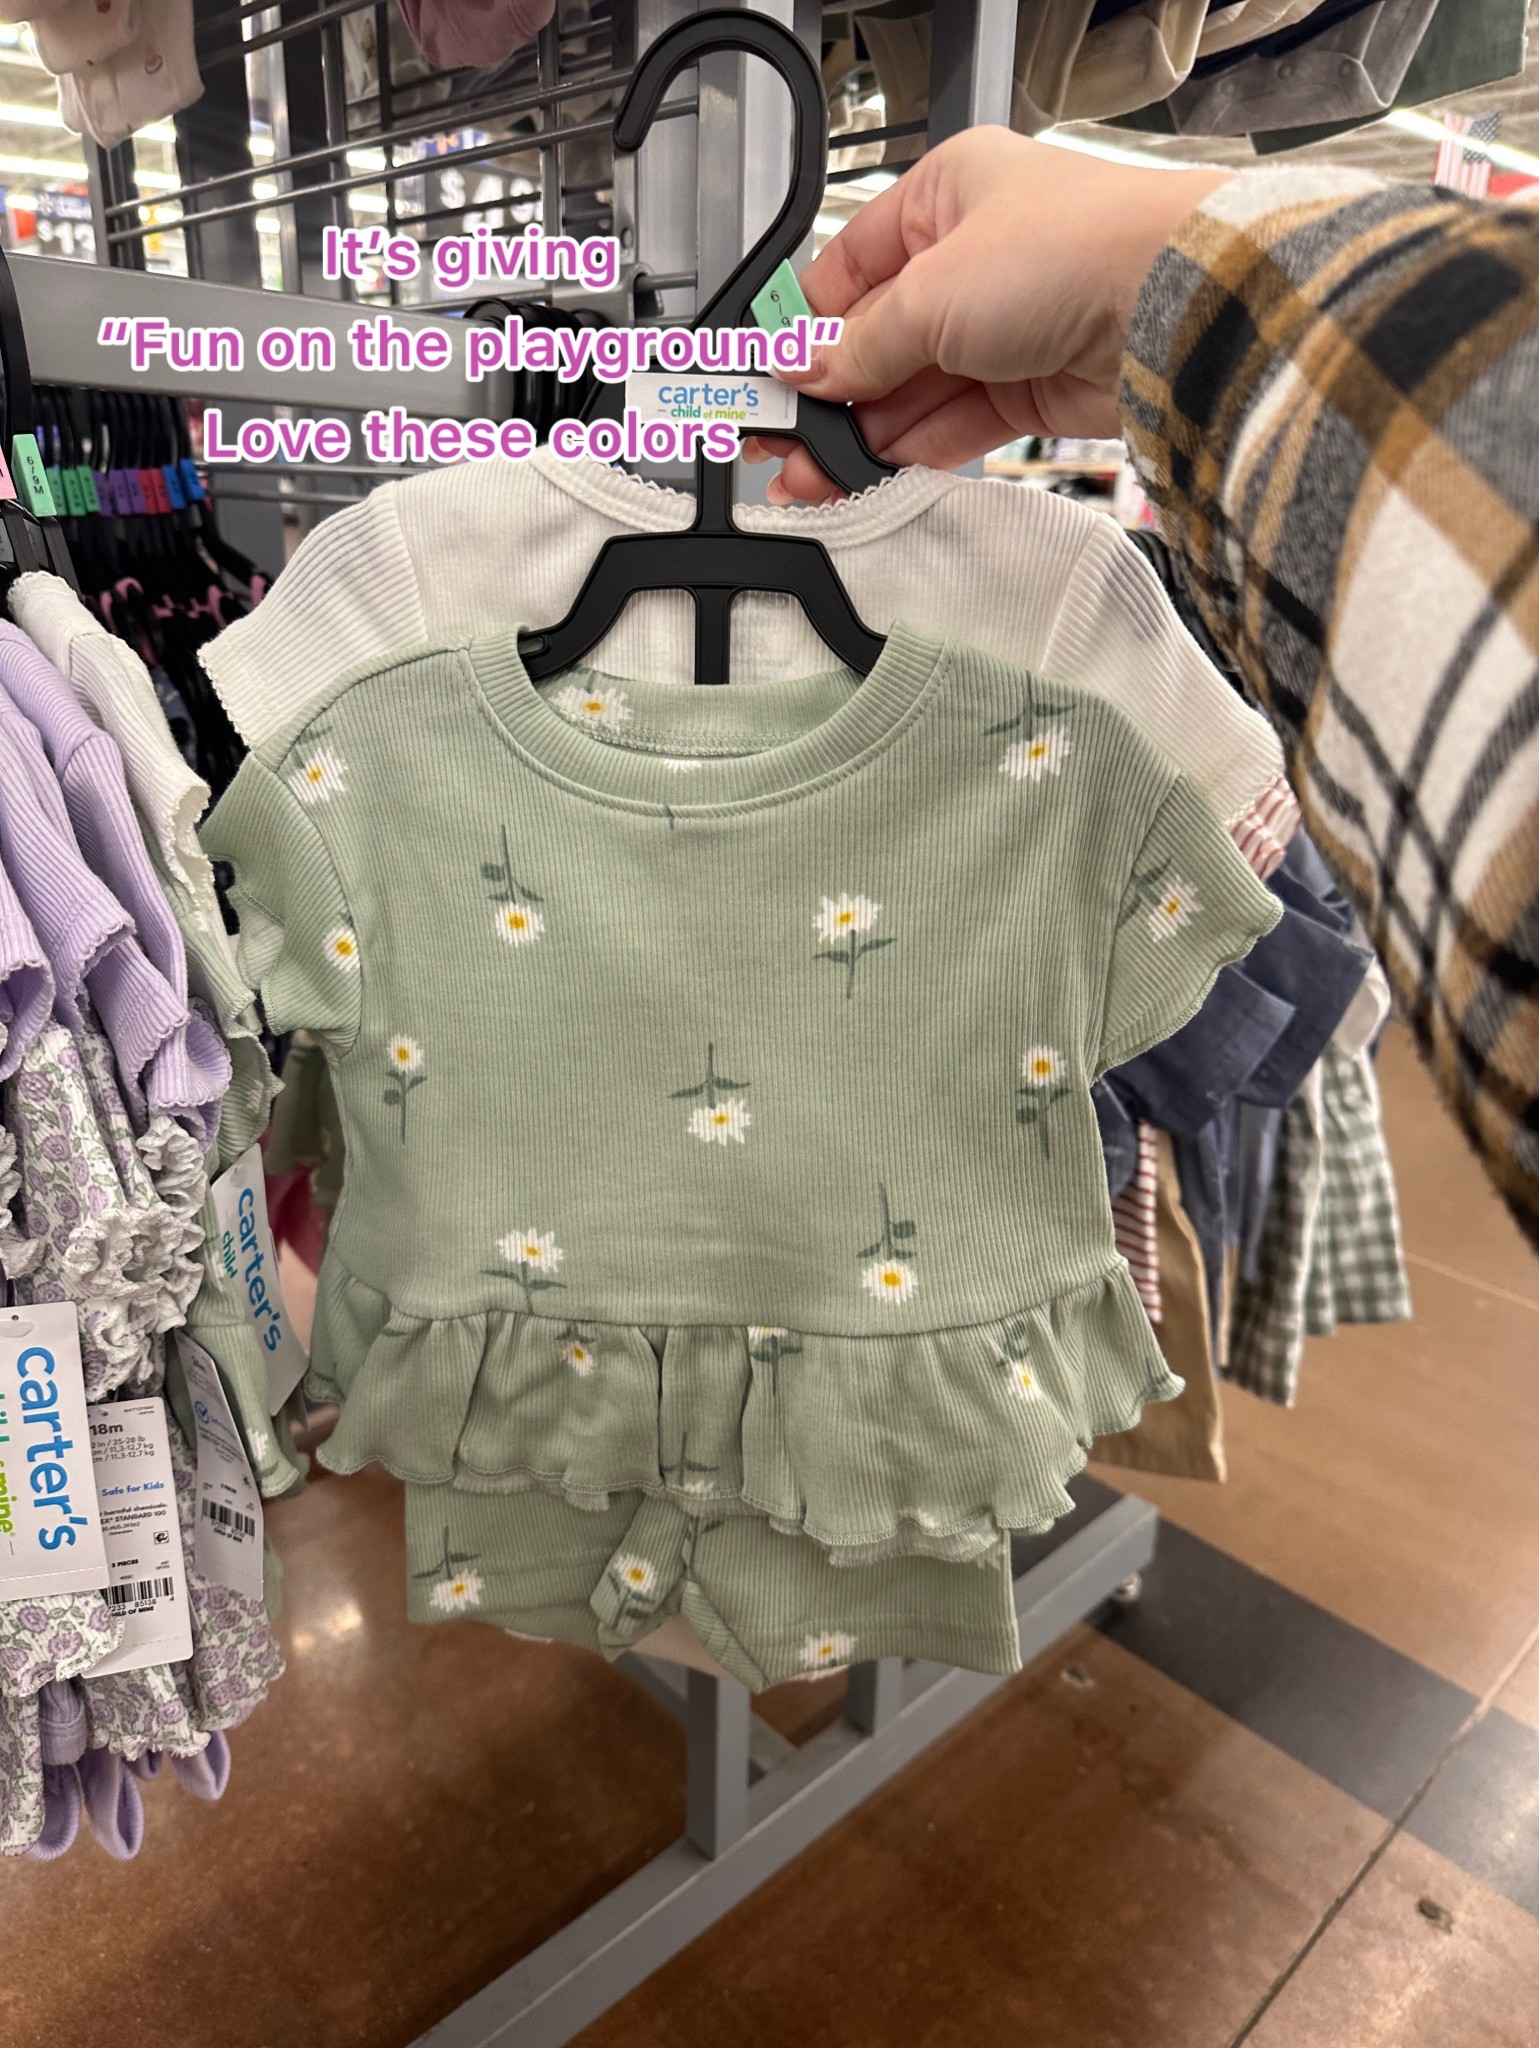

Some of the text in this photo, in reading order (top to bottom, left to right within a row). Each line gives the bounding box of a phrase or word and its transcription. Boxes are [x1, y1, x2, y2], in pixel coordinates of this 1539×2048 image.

[658, 383, 759, 408] carter's
[671, 405, 746, 420] child of mine
[222, 1230, 238, 1279] child
[238, 1188, 281, 1351] carter's
[89, 1423, 123, 1436] 18m
[113, 1436, 136, 1446] 25-28
[143, 1442, 154, 1450] kg
[16, 1346, 88, 1550] carter's
[144, 1449, 155, 1457] kg
[101, 1481, 164, 1496] Safe for Kids
[115, 1511, 153, 1522] STANDARD
[117, 1559, 139, 1567] PIECES
[134, 1598, 157, 1608] 85138
[138, 1605, 154, 1613] MINE
